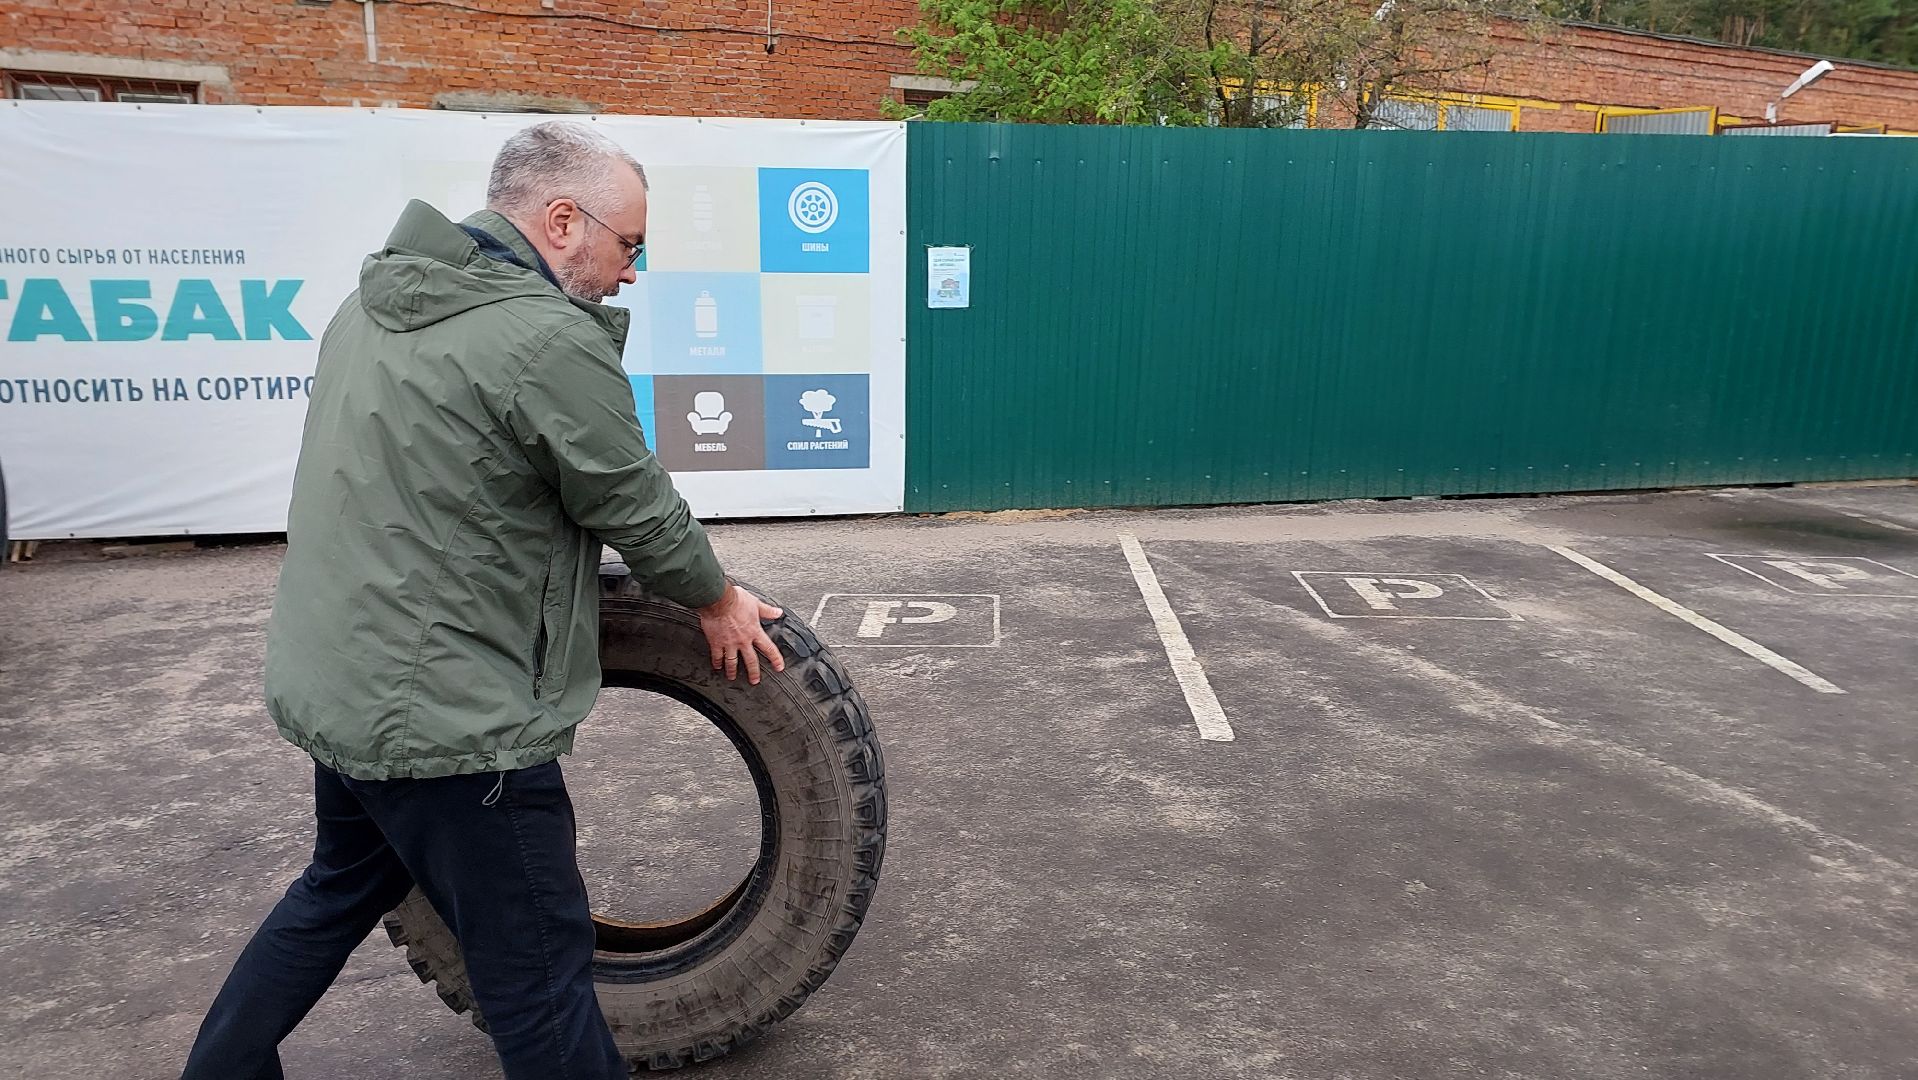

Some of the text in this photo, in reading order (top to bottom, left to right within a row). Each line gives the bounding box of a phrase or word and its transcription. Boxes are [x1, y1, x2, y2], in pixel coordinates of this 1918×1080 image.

[801, 242, 829, 252] ШИНЫ
[0, 248, 245, 265] НОГО СЫРЬЯ ОТ НАСЕЛЕНИЯ
[0, 379, 143, 404] ОТНОСИТЬ
[153, 378, 189, 402] НА
[694, 443, 727, 452] МЕБЕЛЬ
[787, 439, 849, 451] СПИЛ РАСТЕНИЙ
